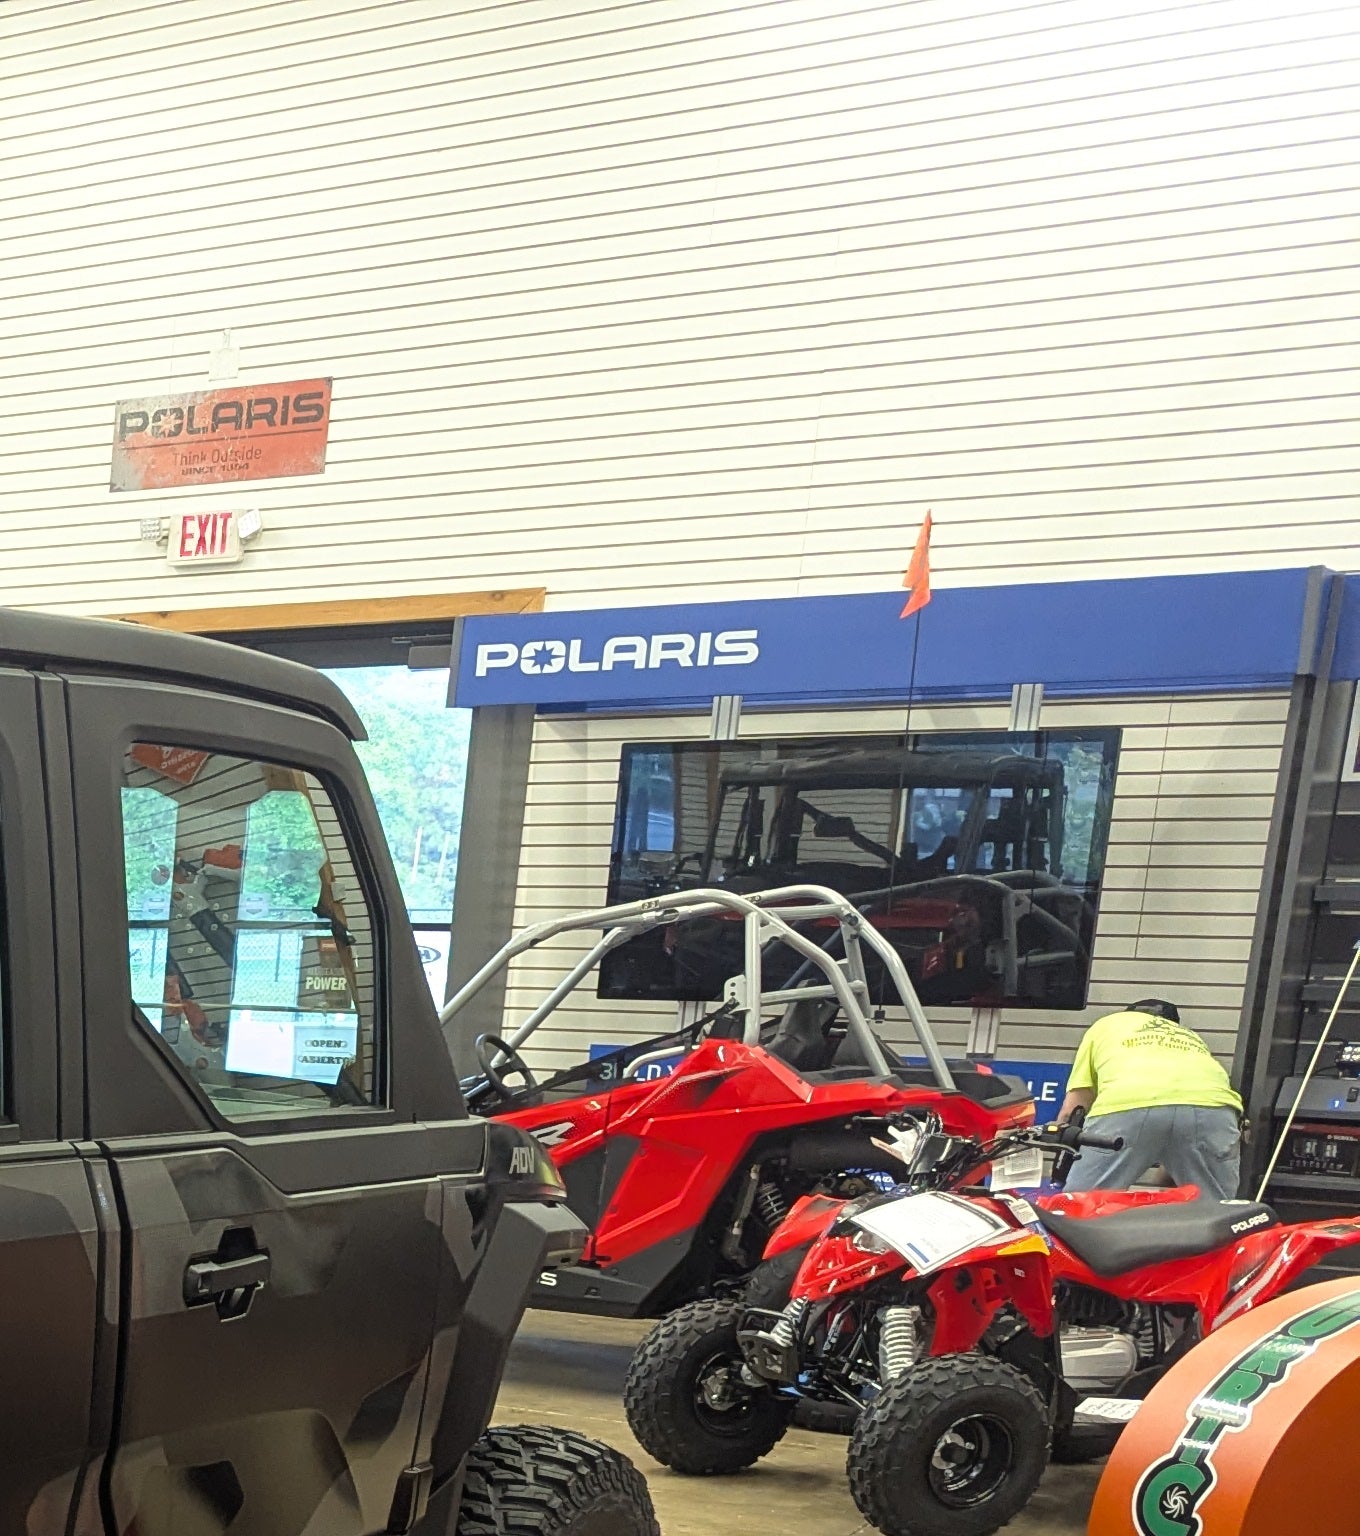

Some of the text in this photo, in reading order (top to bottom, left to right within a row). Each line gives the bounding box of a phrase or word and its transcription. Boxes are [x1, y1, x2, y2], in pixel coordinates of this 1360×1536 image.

[118, 391, 325, 443] POLARIS
[172, 445, 262, 467] Think Outside
[179, 512, 233, 558] EXIT
[475, 629, 760, 679] POLARIS
[305, 976, 347, 991] POWER
[311, 1039, 342, 1048] OPEN
[509, 1146, 535, 1174] ADV
[1230, 1212, 1270, 1234] POLARIS
[820, 1261, 889, 1293] POLARS
